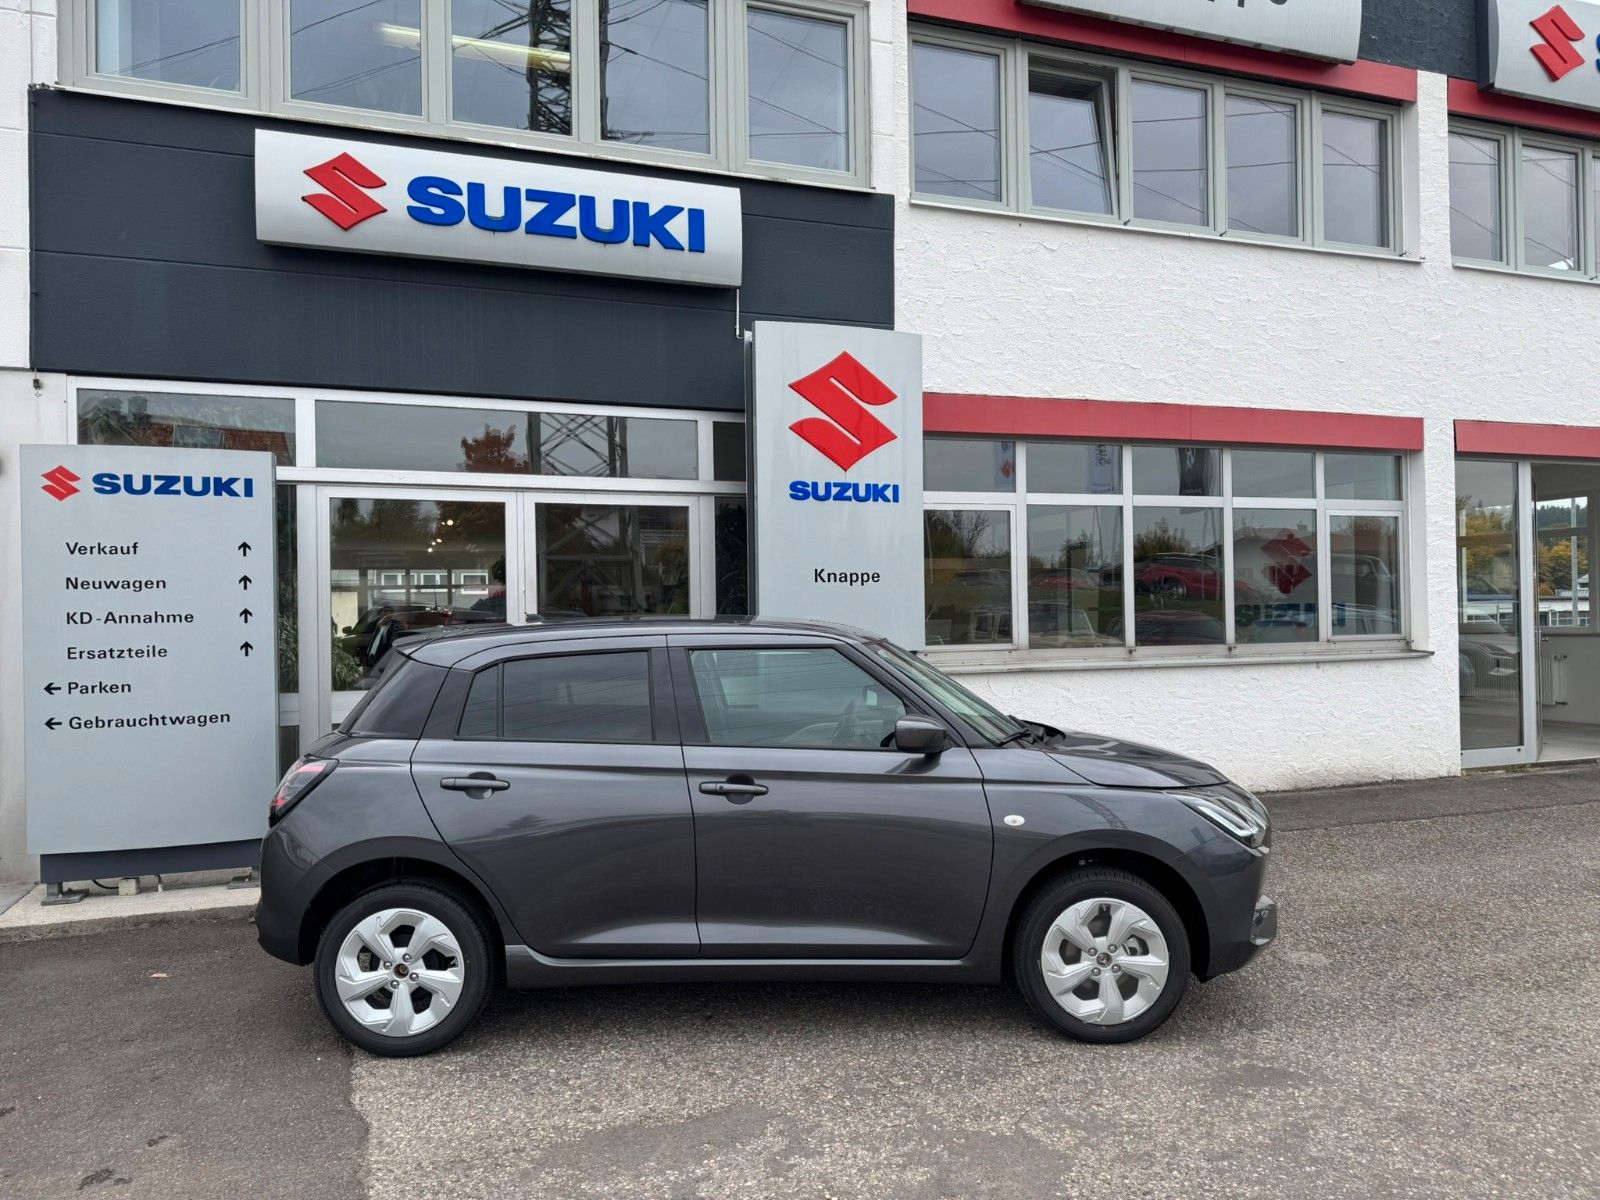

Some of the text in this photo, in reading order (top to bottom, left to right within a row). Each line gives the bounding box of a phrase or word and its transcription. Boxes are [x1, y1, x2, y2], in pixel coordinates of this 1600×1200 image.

[407, 175, 705, 253] SUZUKI
[92, 473, 254, 498] SUZUKI
[789, 480, 900, 503] SUZUKI
[65, 541, 139, 556] Verkauf
[65, 576, 166, 592] Neuwagen
[814, 568, 881, 587] Knappe
[67, 644, 168, 660] Ersatzteile
[68, 680, 132, 695] Parken
[68, 713, 231, 730] Gebrauchtwagen
